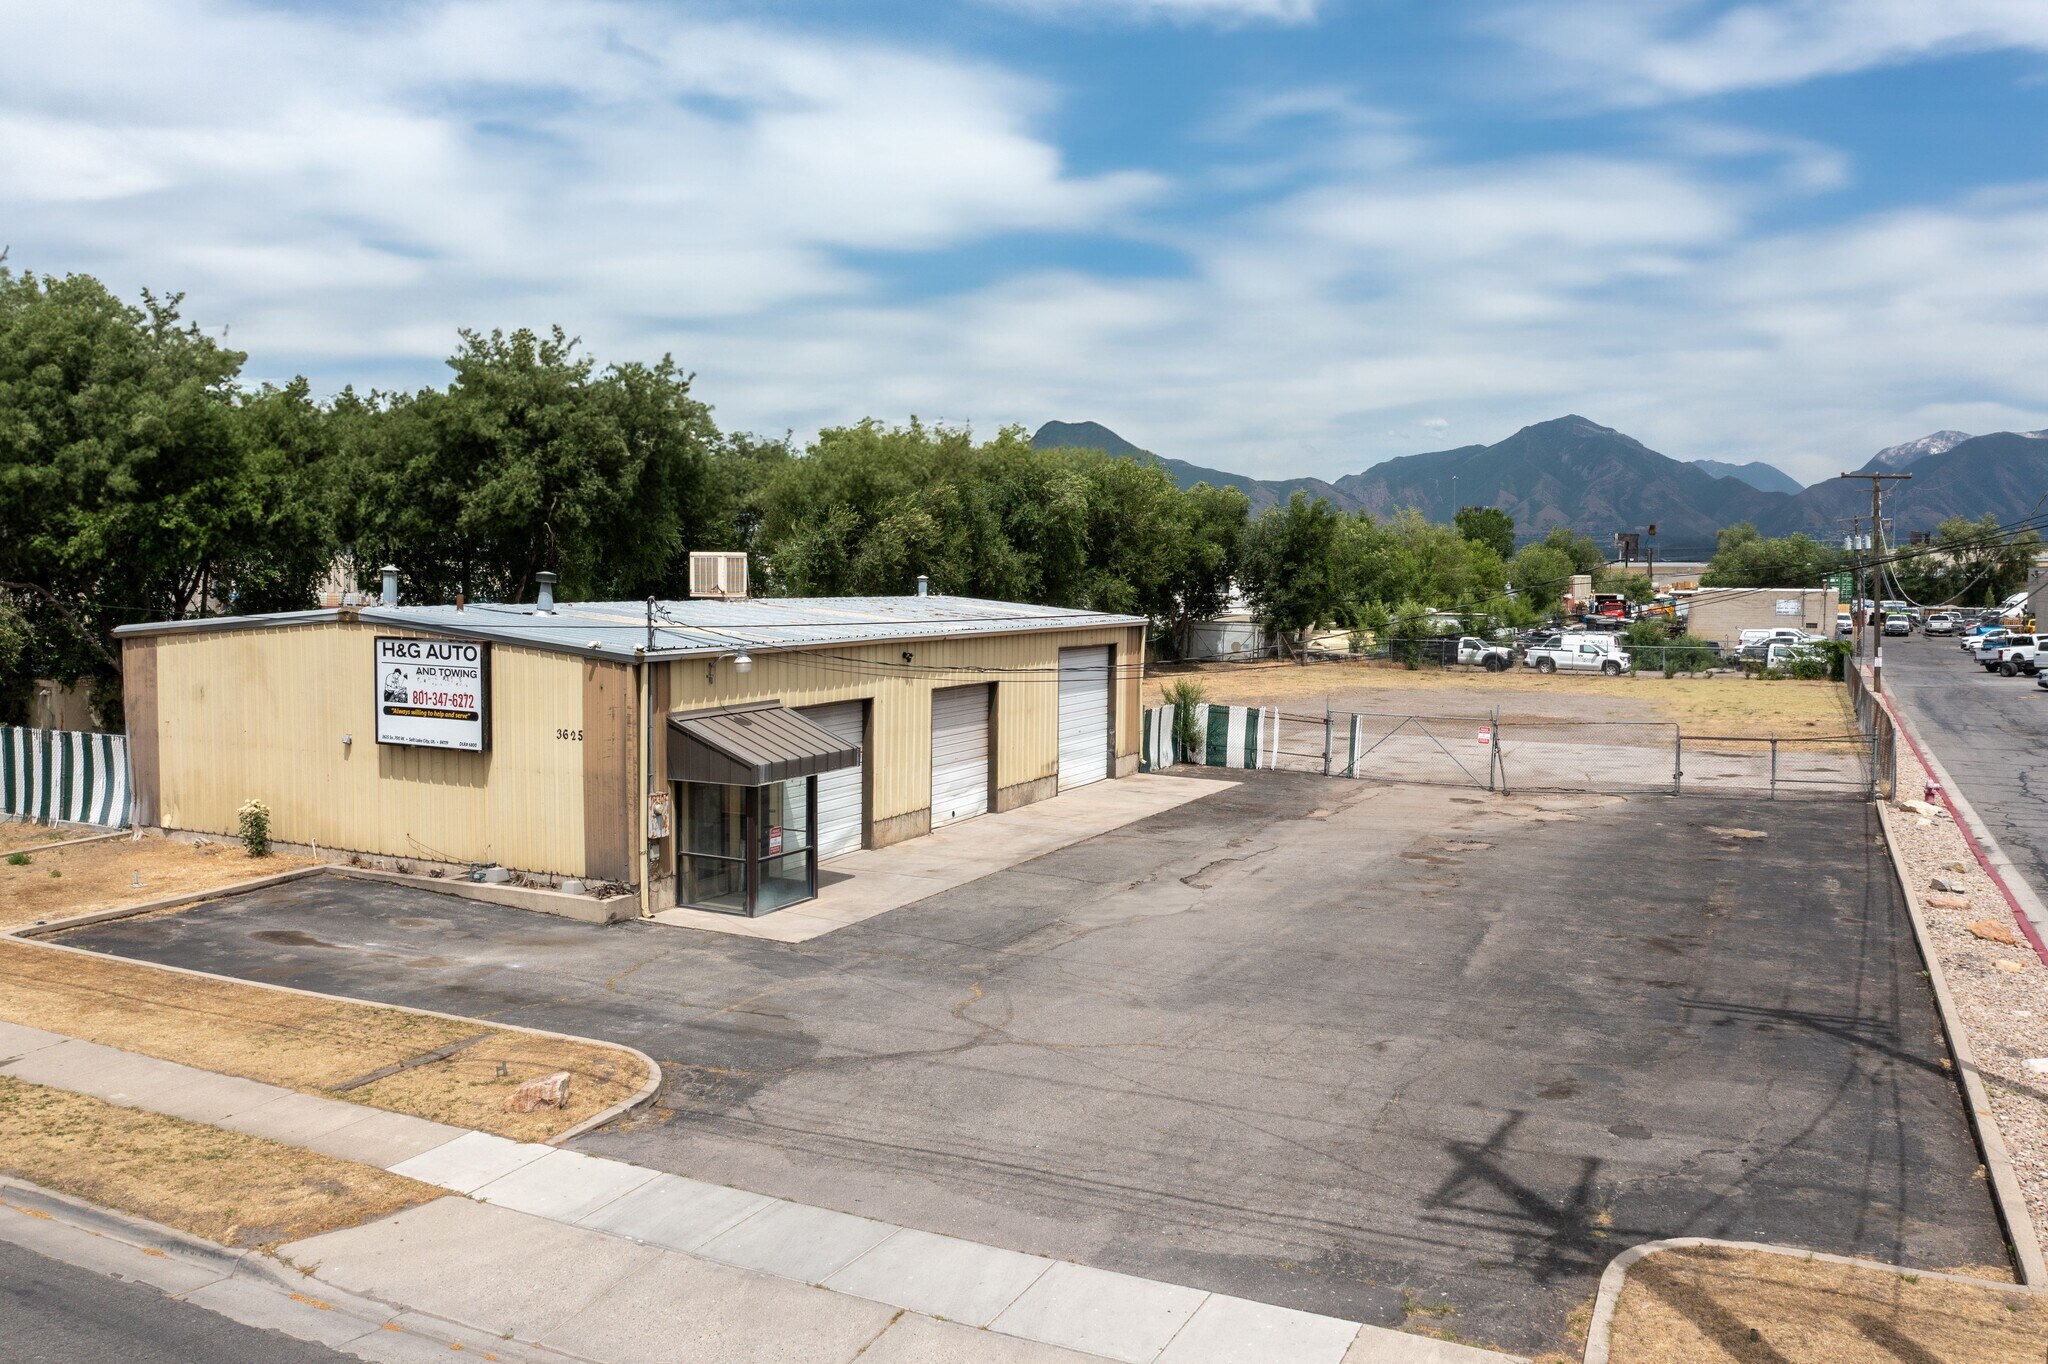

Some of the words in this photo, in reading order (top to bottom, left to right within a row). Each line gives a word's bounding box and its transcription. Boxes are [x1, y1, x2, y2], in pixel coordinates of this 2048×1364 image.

[383, 642, 420, 658] H&G
[426, 644, 477, 661] AUTO
[416, 667, 437, 676] AND
[439, 668, 478, 679] TOWING
[412, 691, 474, 708] 801-347-6272
[411, 709, 427, 717] willing
[433, 710, 444, 718] help
[556, 728, 583, 741] 3625
